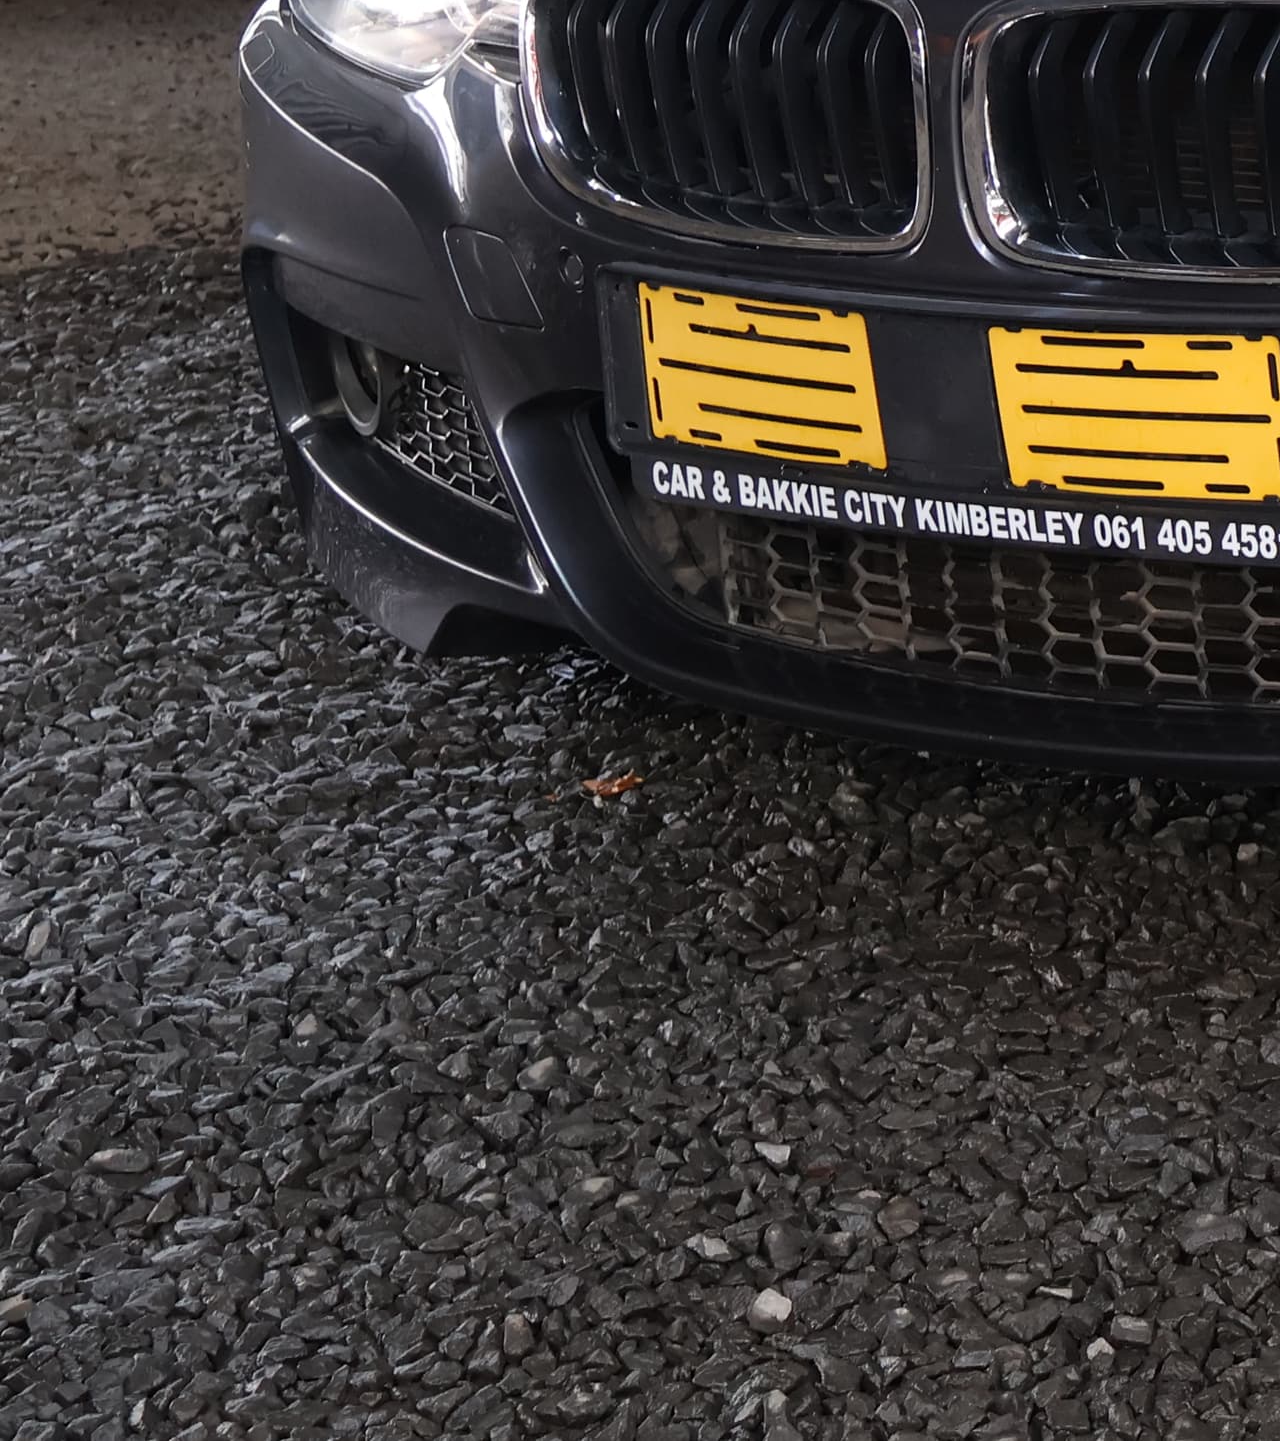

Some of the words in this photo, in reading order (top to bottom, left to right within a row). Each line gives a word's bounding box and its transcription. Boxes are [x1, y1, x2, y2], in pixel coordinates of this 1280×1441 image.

[652, 461, 705, 500] CAR
[712, 469, 732, 504] &
[738, 474, 838, 520] BAKKIE
[844, 489, 906, 528] CITY
[915, 498, 1084, 546] KIMBERLEY
[1093, 514, 1147, 550] 061
[1157, 519, 1212, 555] 405
